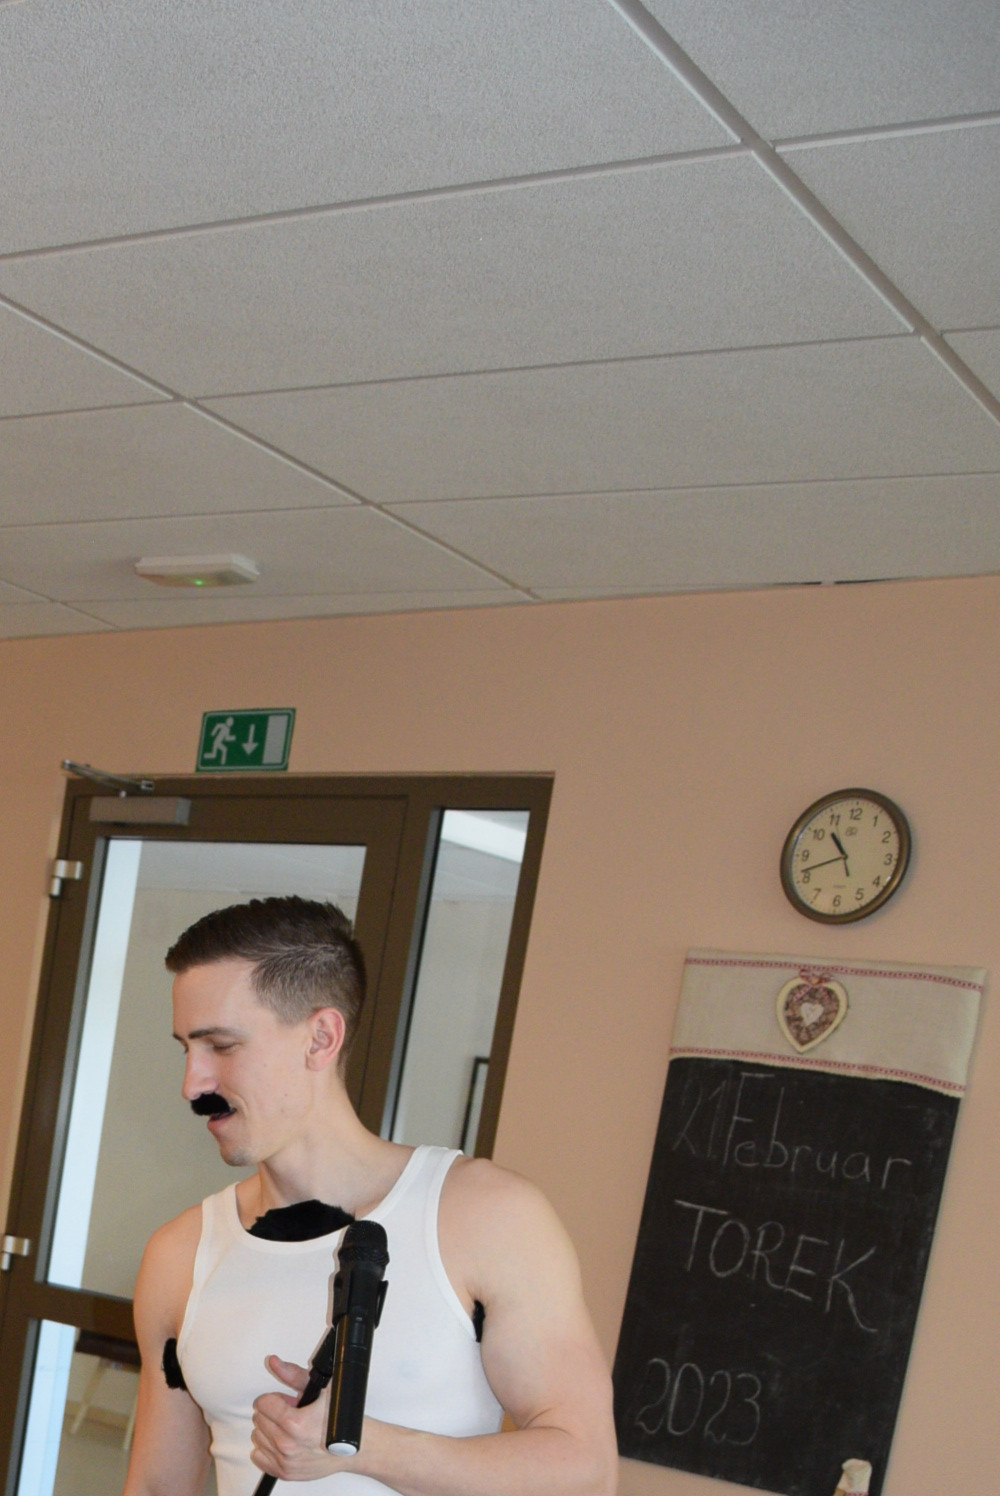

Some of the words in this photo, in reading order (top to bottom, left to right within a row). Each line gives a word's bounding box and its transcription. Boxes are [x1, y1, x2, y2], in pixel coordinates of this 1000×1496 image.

[850, 808, 863, 820] 12
[830, 815, 841, 826] 11
[873, 816, 879, 828] 1
[813, 829, 825, 841] 10
[882, 832, 892, 843] 2
[802, 850, 810, 862] 9
[884, 854, 893, 866] 3
[802, 871, 811, 883] 8
[872, 875, 881, 888] 4
[814, 888, 822, 900] 7
[855, 888, 865, 901] 5
[833, 894, 842, 908] 6
[722, 1072, 912, 1190] Februar
[674, 1199, 878, 1332] TOREK
[634, 1357, 762, 1446] 2023
